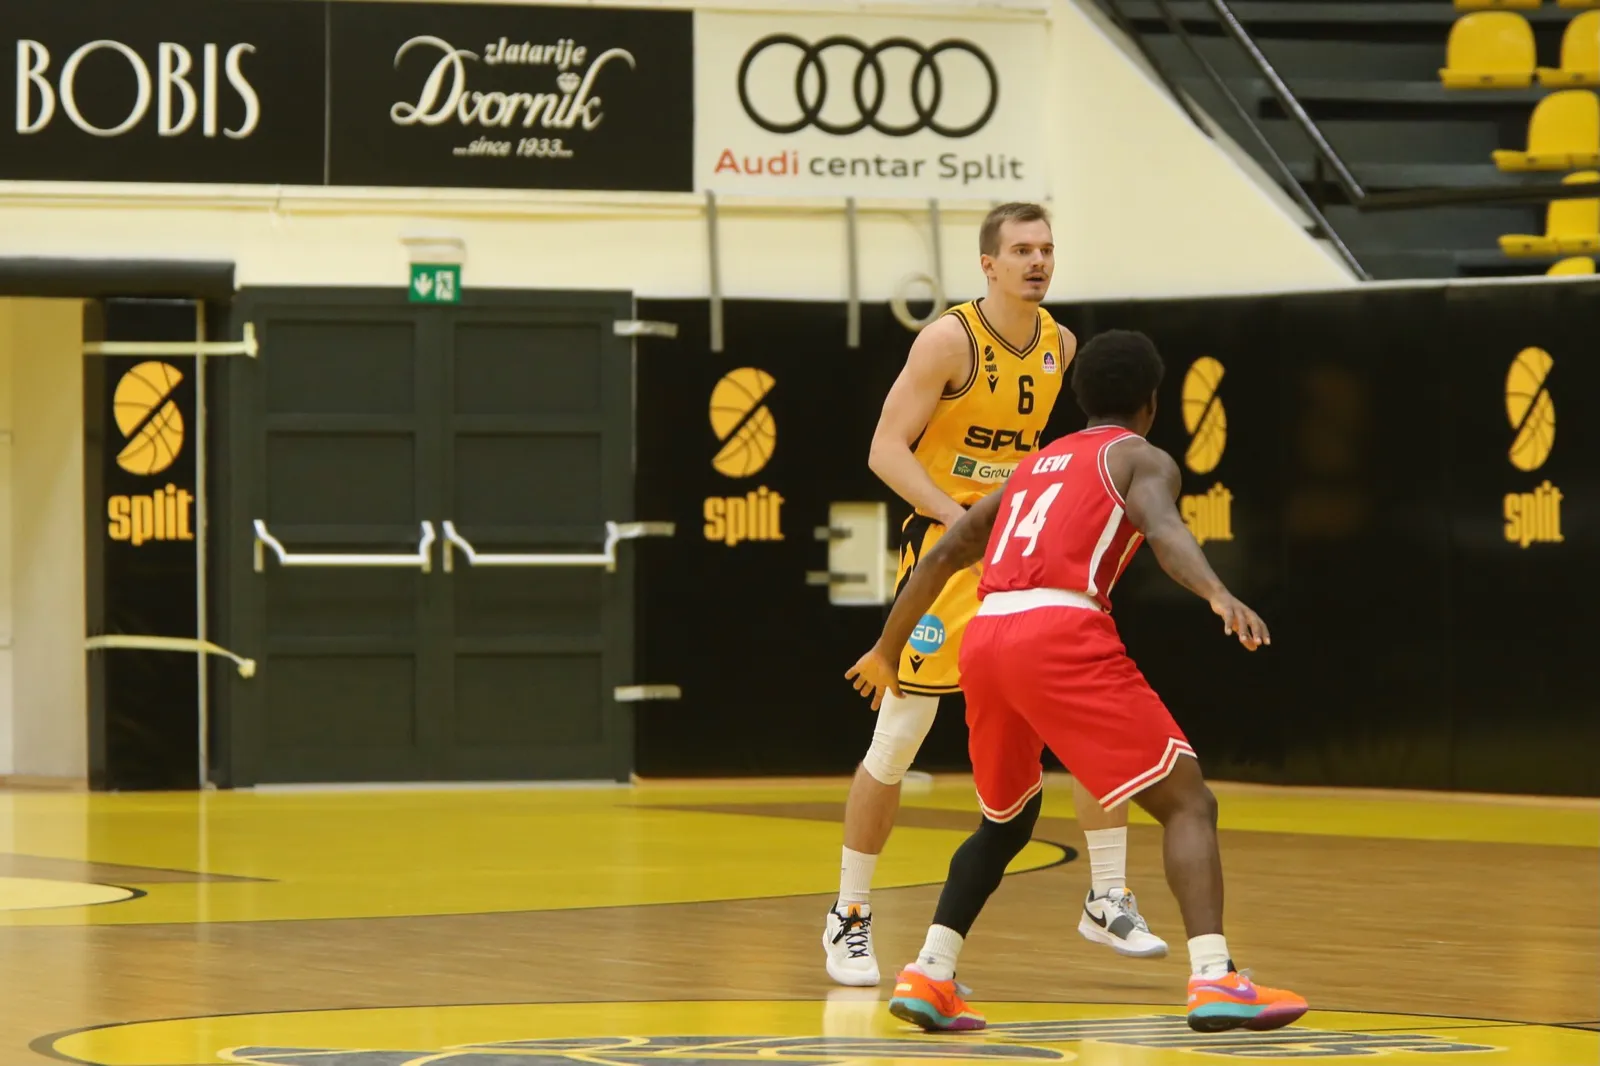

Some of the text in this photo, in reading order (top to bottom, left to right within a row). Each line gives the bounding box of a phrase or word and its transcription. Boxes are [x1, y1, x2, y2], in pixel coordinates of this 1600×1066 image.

[390, 35, 637, 131] Dvornik
[482, 36, 588, 71] zlatarije
[16, 39, 261, 139] BOBIS
[714, 148, 1024, 185] Audi centar Split
[1017, 374, 1035, 416] 6
[1031, 453, 1073, 475] LEVI
[107, 483, 194, 547] split
[703, 485, 785, 548] split
[990, 482, 1063, 566] 14
[1181, 481, 1234, 547] split
[1503, 479, 1565, 549] split
[910, 624, 944, 645] GDi
